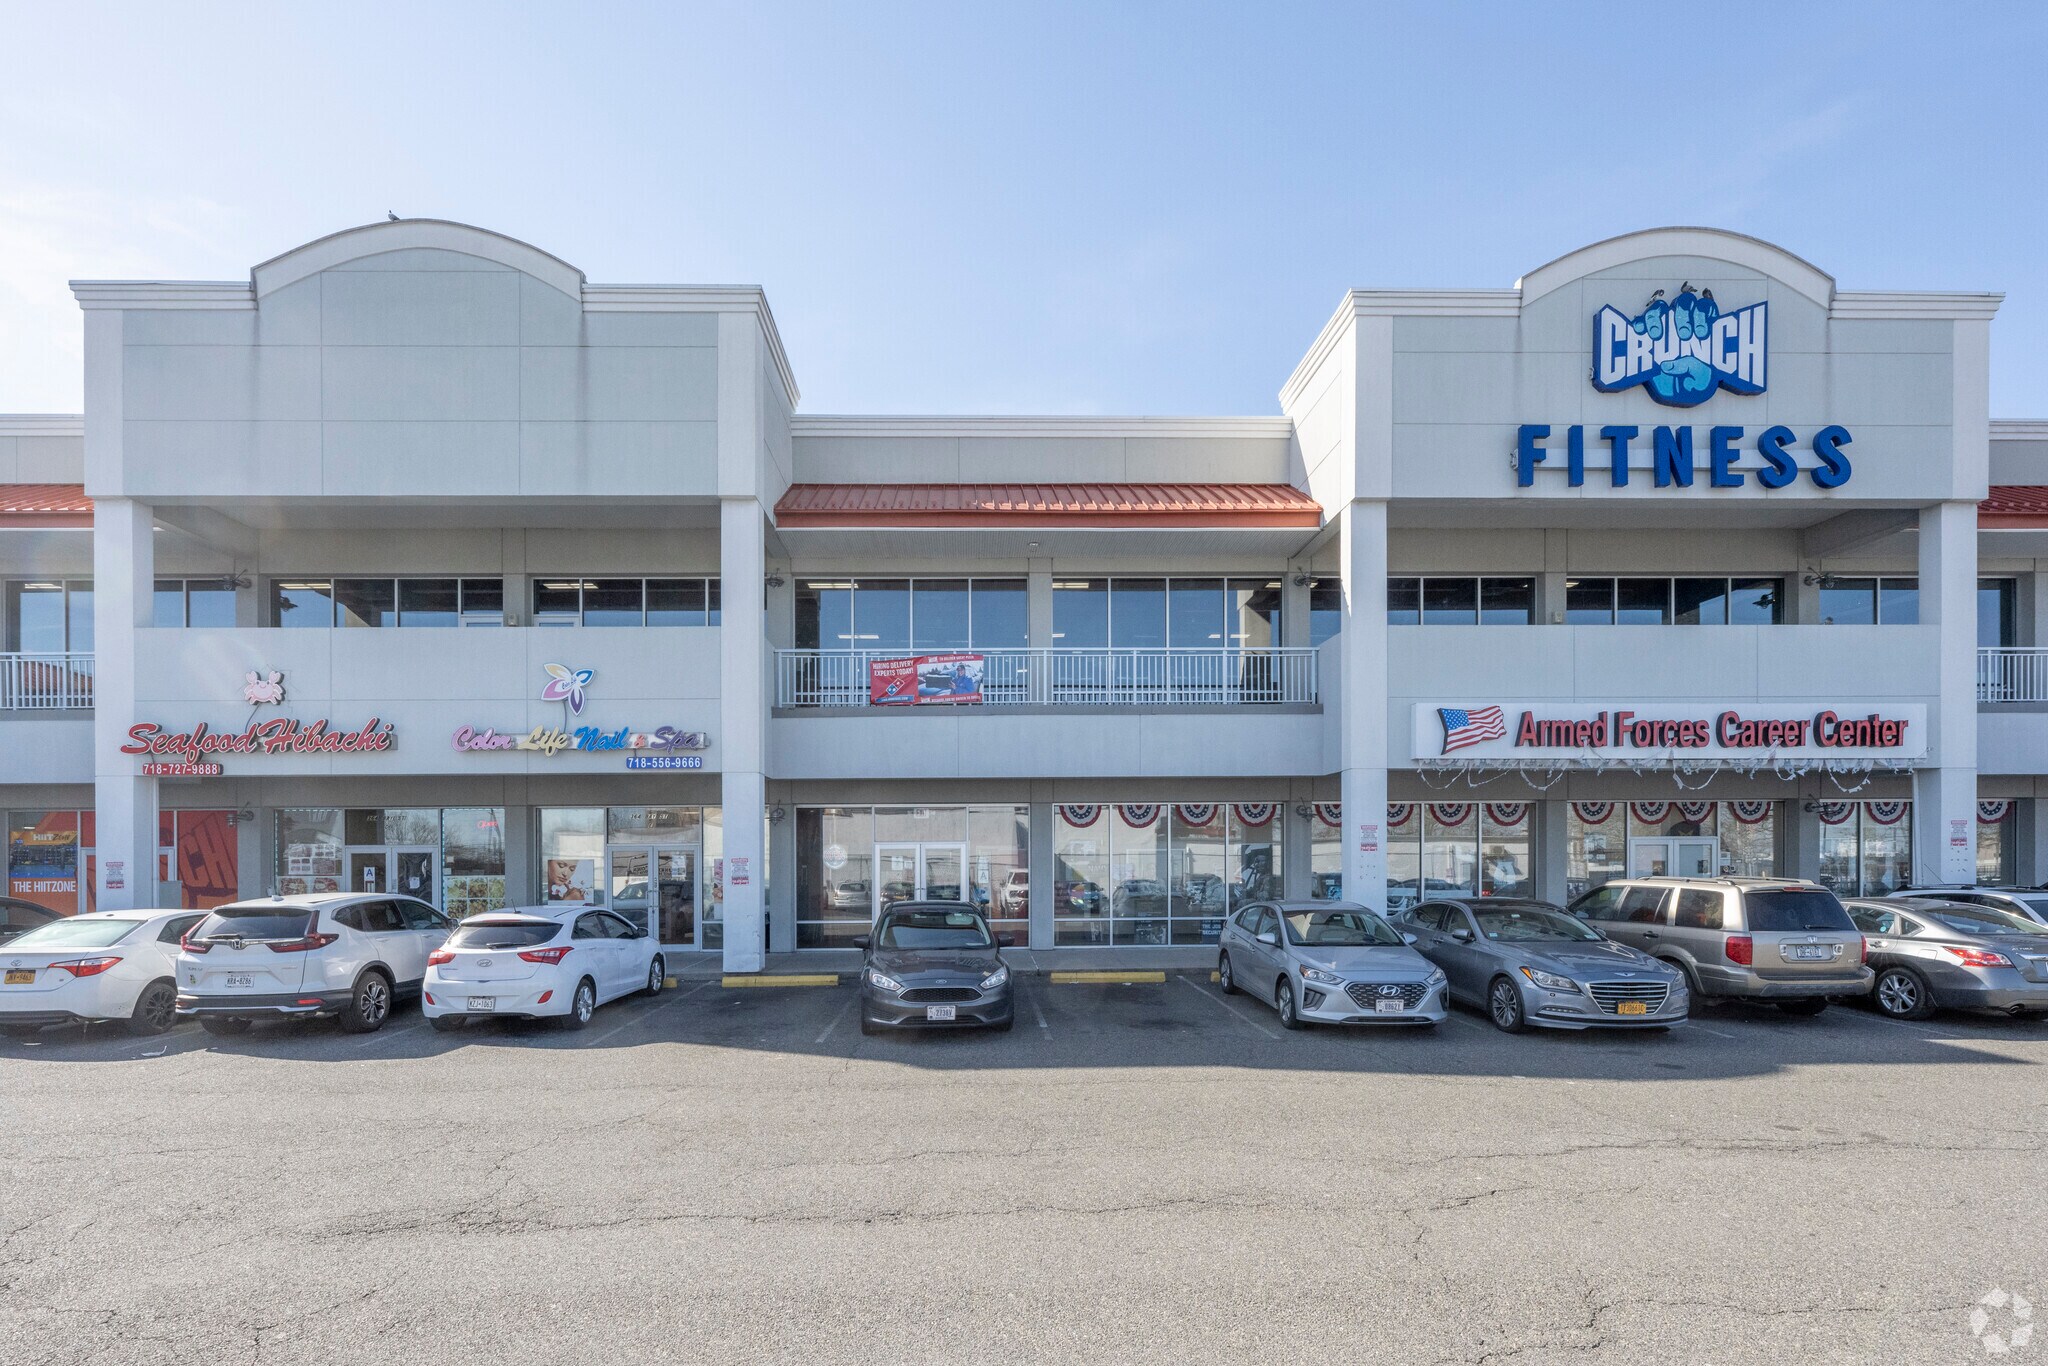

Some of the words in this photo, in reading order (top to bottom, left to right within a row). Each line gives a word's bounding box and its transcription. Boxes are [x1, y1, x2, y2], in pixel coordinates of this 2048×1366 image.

[1600, 303, 1766, 387] CRUNCH
[1518, 424, 1853, 489] FITNESS
[890, 660, 914, 669] DELIVERY
[874, 669, 896, 677] EXPERTS
[1515, 711, 1609, 747] Armed
[1613, 711, 1710, 747] Forces
[1716, 710, 1810, 747] Career
[1813, 710, 1909, 747] Center
[120, 721, 259, 765] Seafood
[257, 716, 395, 755] Hibachi
[451, 724, 513, 752] Color
[517, 725, 569, 757] Life
[573, 725, 630, 753] Nail
[650, 726, 699, 754] Spa
[628, 757, 701, 768] 718-556-9666
[143, 763, 218, 775] 718-727-9888
[366, 868, 374, 877] A
[13, 881, 32, 893] THE
[33, 881, 76, 893] HIITZONE
